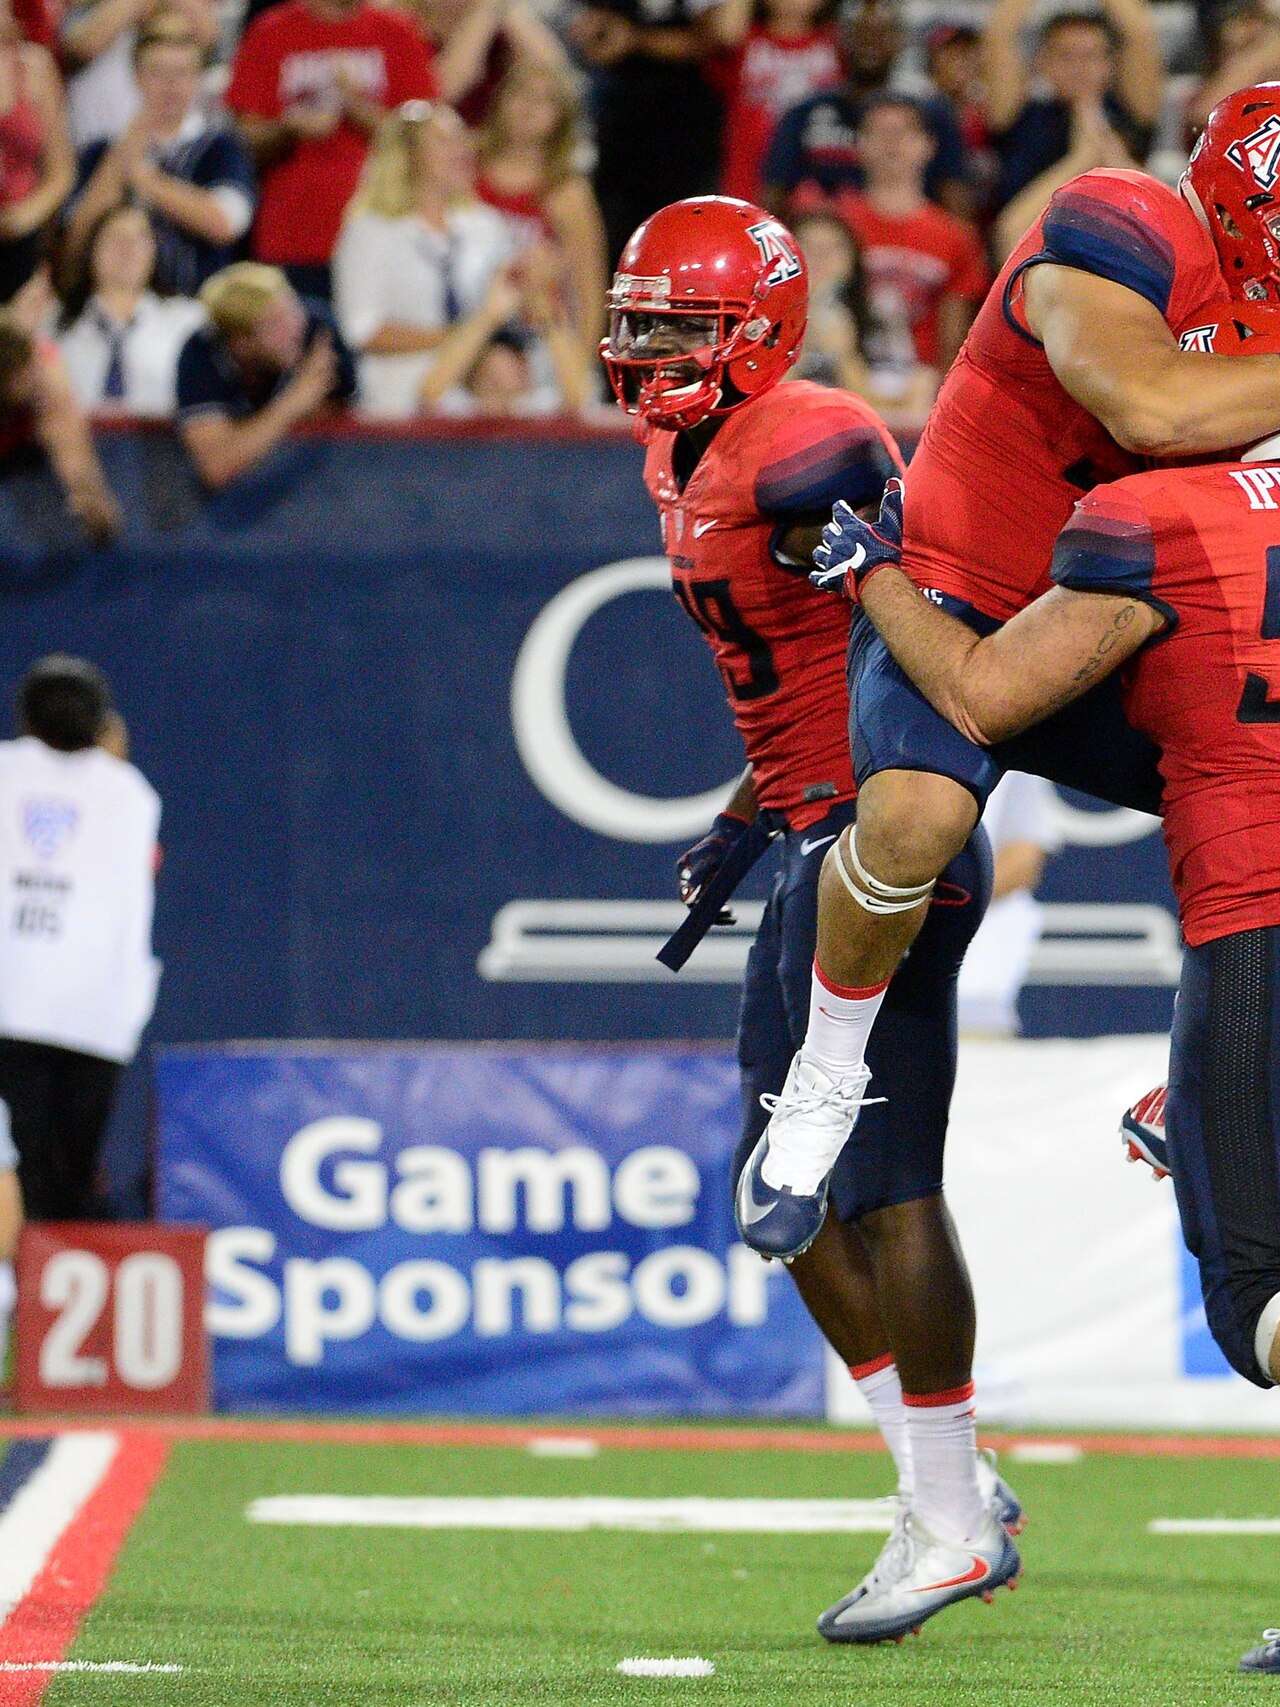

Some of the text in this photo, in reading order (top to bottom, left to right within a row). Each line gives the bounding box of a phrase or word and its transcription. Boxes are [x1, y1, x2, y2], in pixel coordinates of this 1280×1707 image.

[746, 220, 803, 288] A
[280, 1117, 701, 1234] Game
[39, 1250, 184, 1390] 20
[206, 1227, 775, 1367] Sponsor
